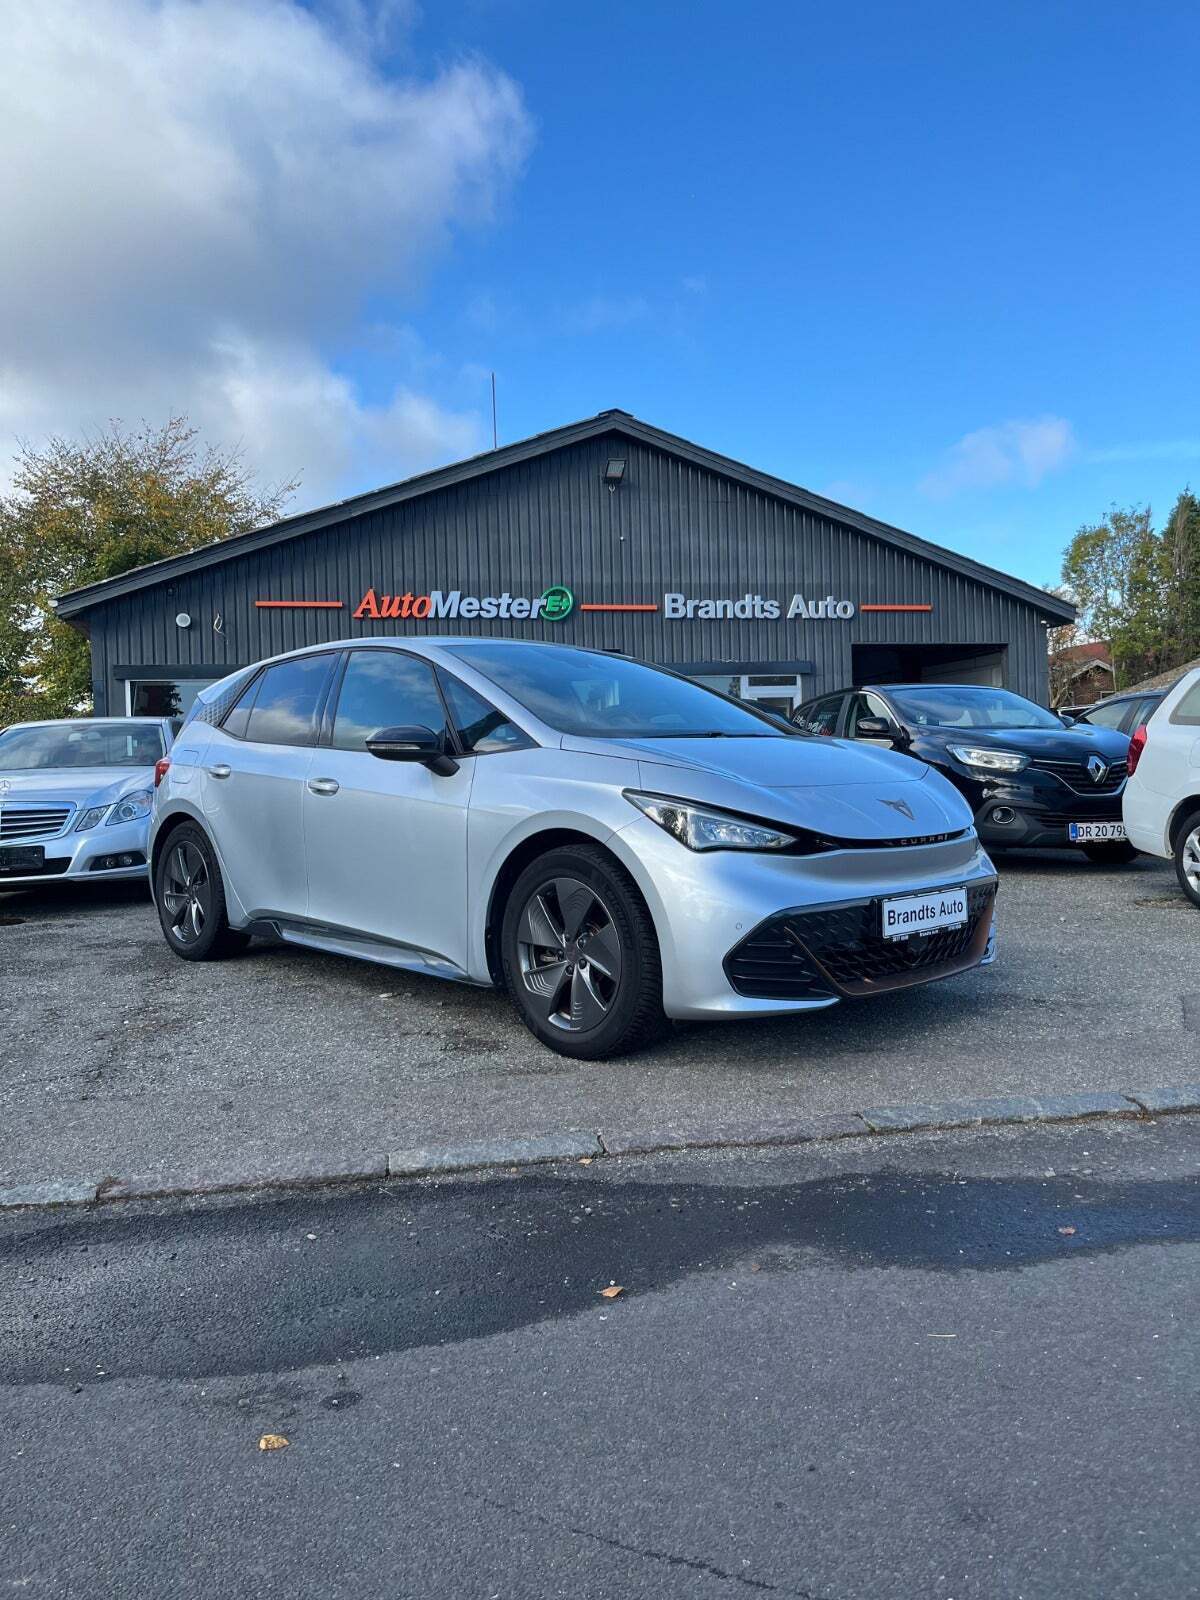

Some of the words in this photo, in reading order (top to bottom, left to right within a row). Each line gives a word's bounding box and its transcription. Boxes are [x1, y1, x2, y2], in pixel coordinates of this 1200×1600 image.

[353, 587, 547, 619] AutoMester
[664, 593, 780, 619] Brandts
[787, 594, 854, 619] Auto
[1078, 826, 1092, 837] DR
[1095, 825, 1108, 837] 20
[887, 904, 936, 926] Brandts
[939, 900, 964, 917] Auto
